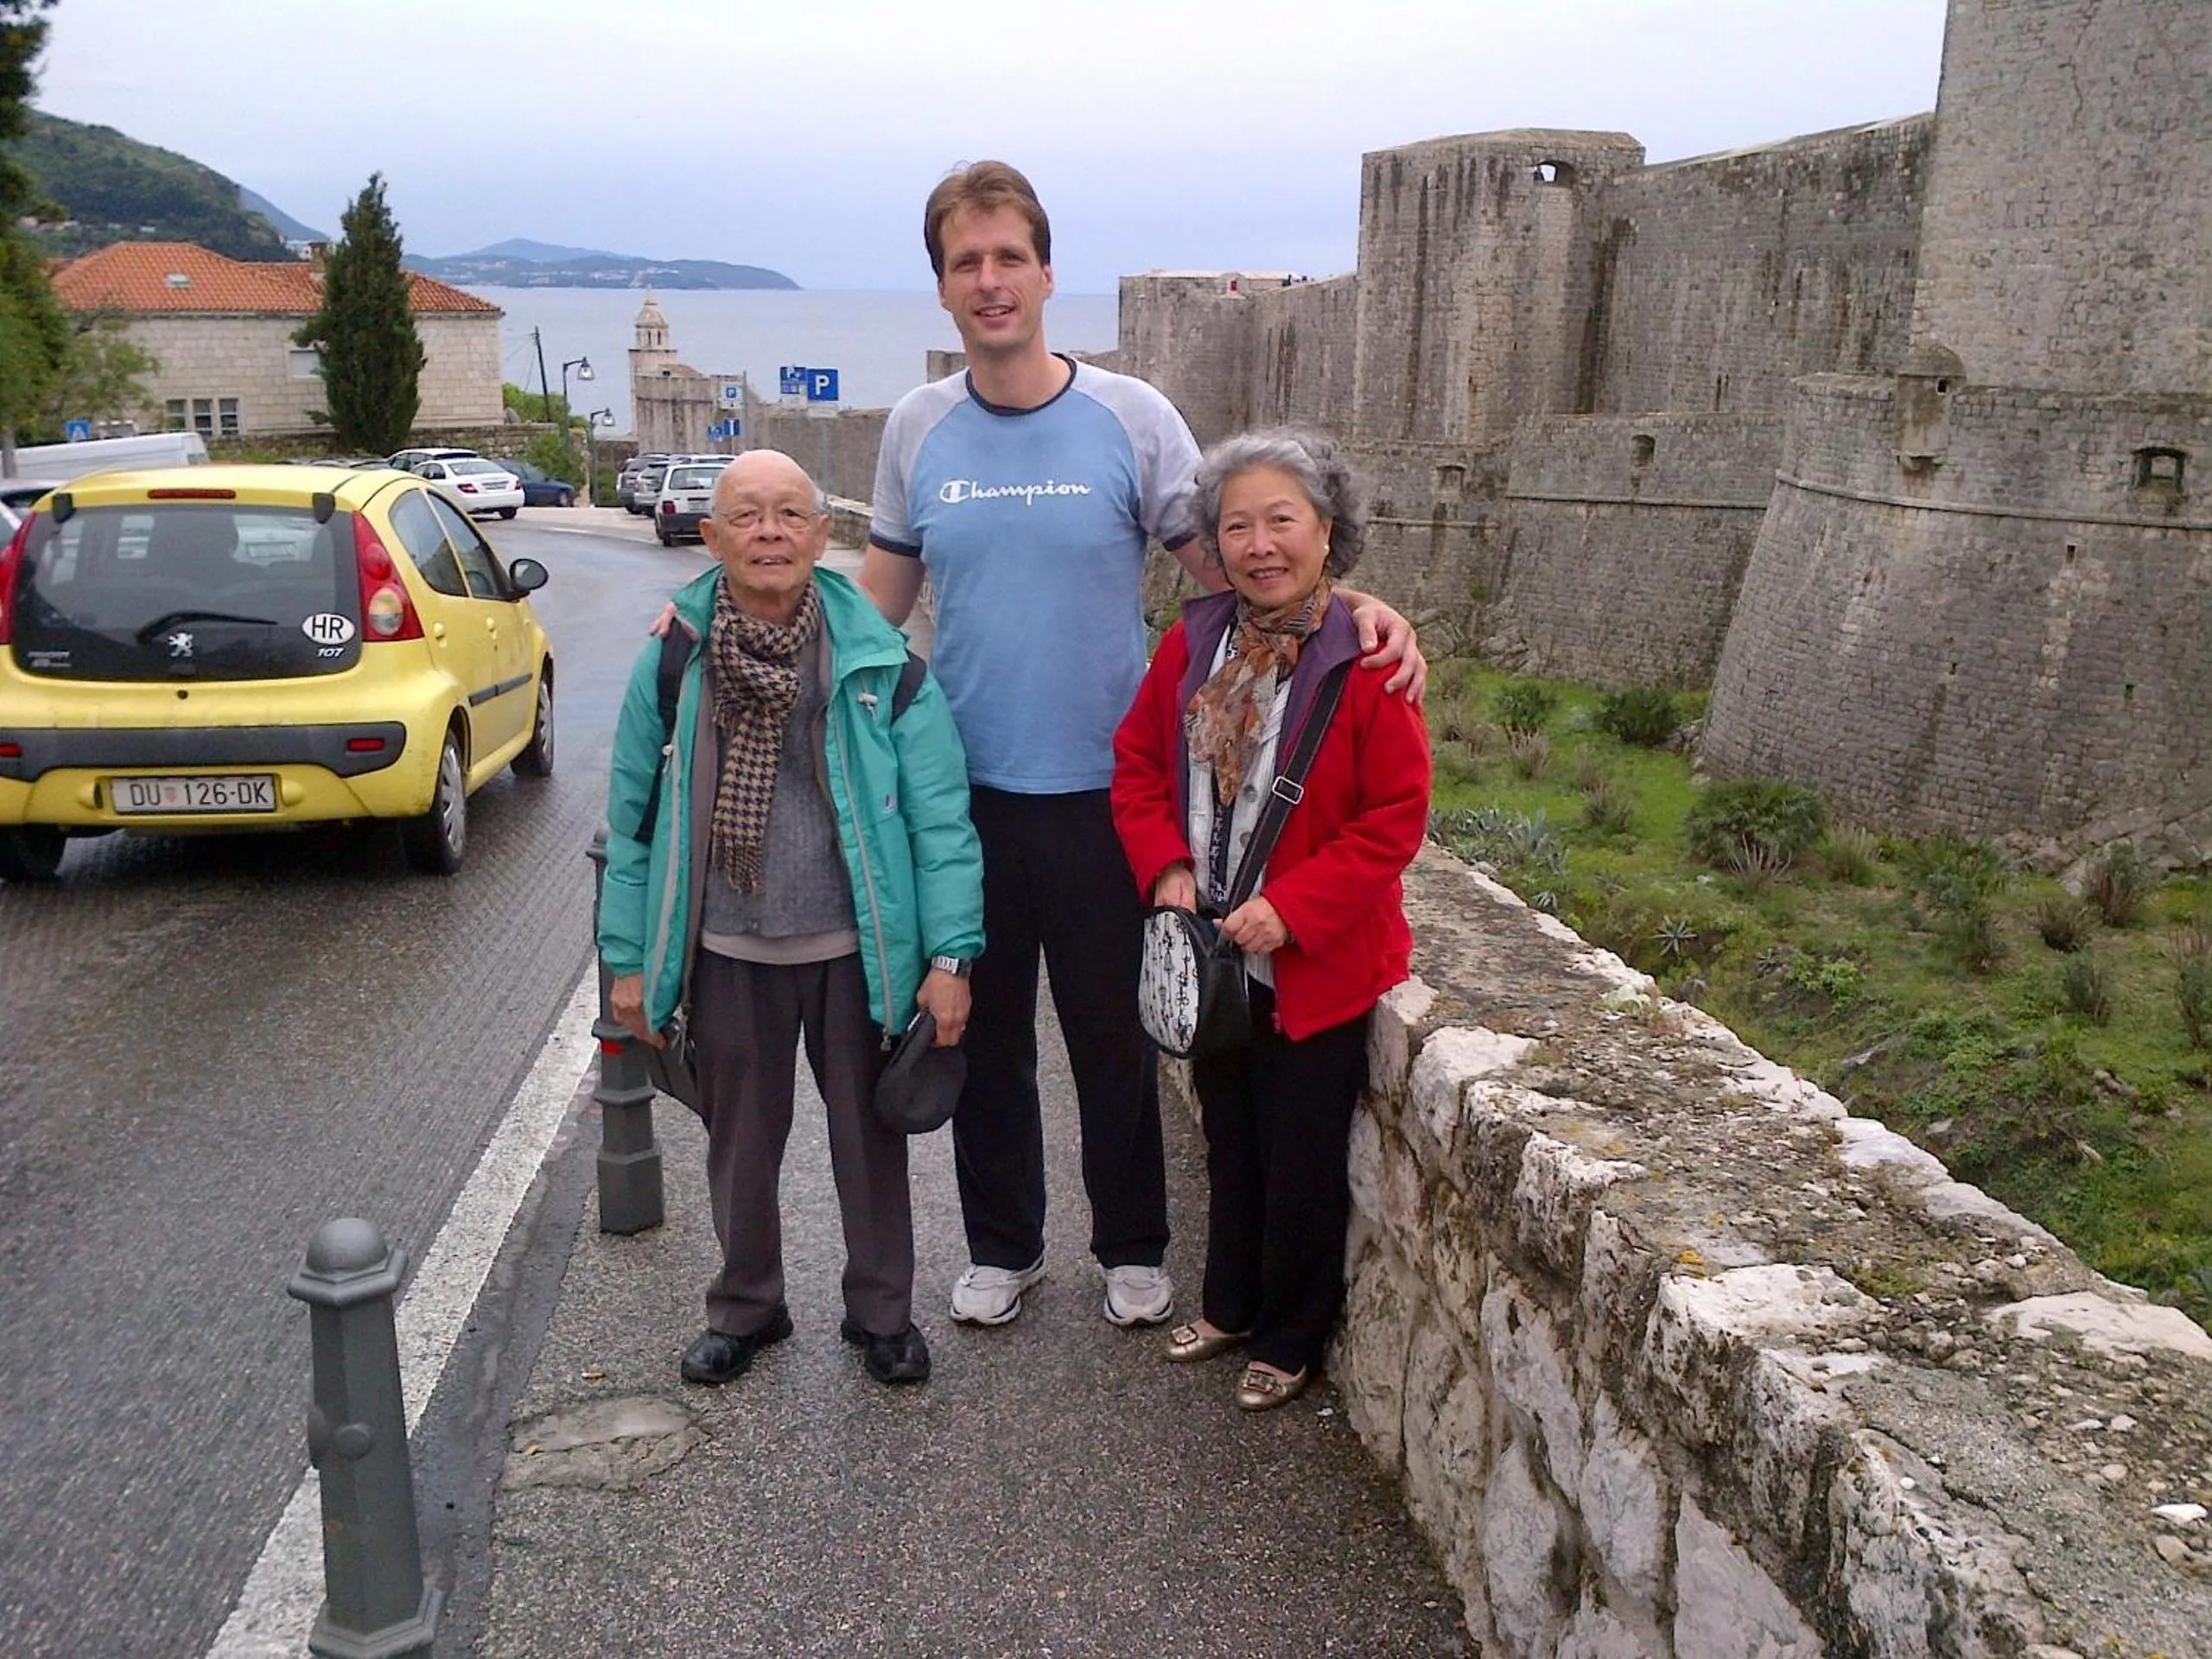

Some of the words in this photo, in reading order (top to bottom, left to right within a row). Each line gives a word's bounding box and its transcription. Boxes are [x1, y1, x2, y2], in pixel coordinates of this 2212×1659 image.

[815, 374, 830, 396] P
[939, 480, 1091, 506] Champion
[312, 616, 343, 639] HR
[318, 648, 344, 657] 107
[130, 784, 161, 805] DU
[184, 781, 269, 805] 126-DK
